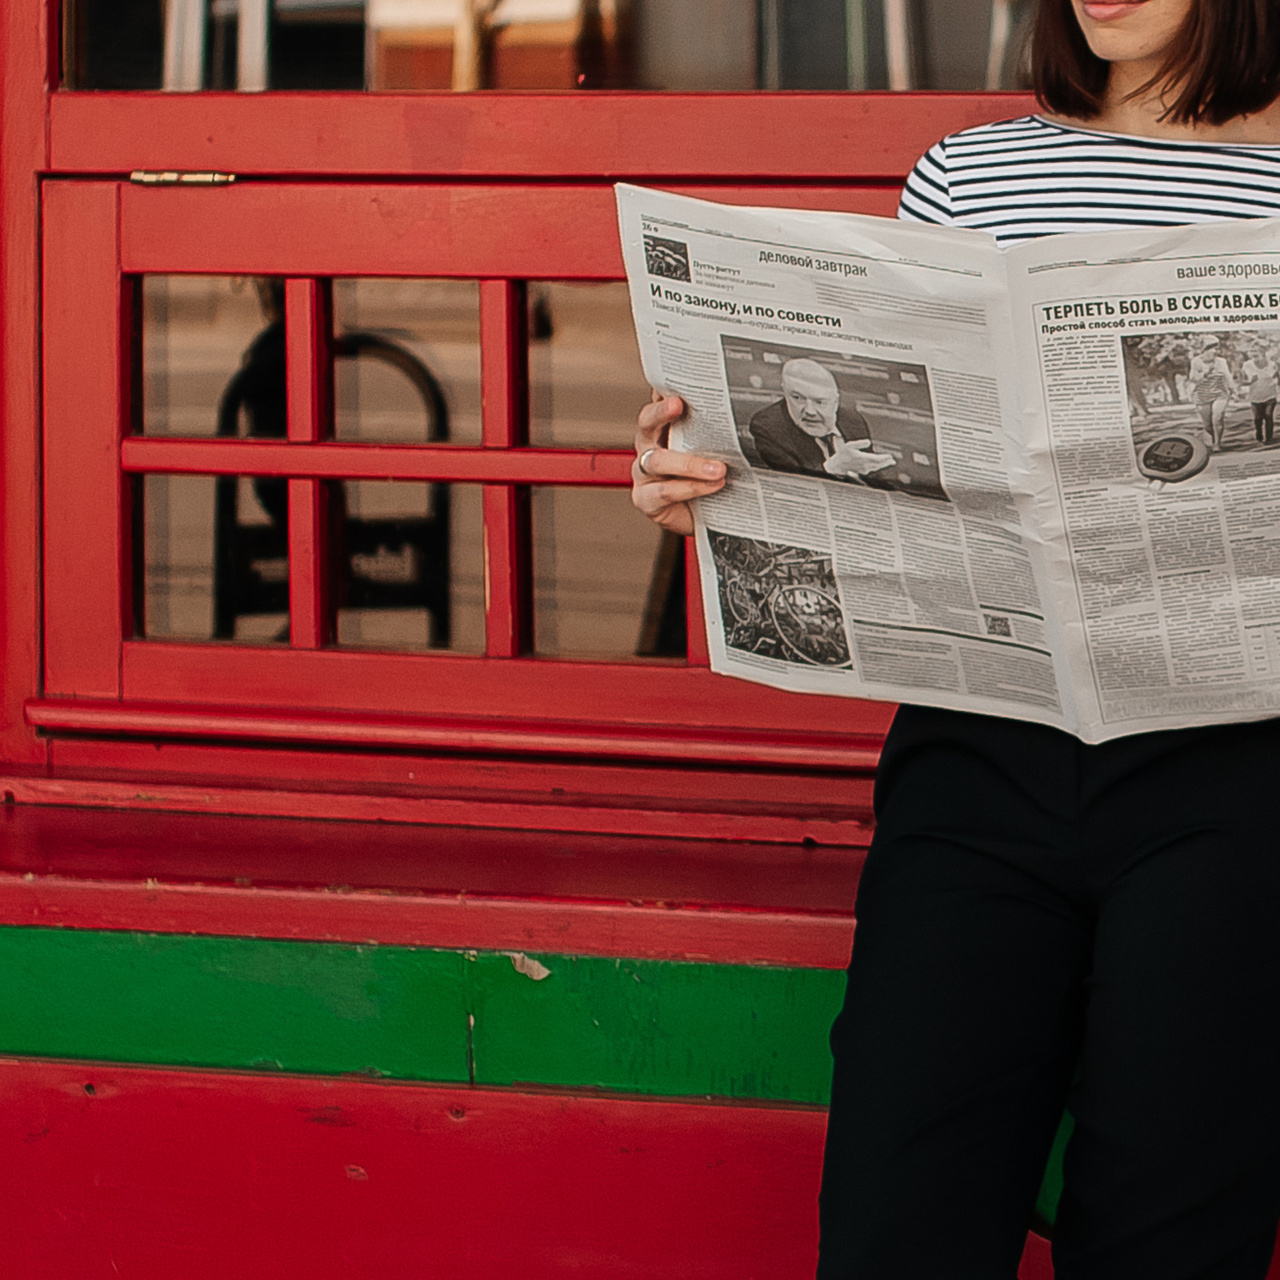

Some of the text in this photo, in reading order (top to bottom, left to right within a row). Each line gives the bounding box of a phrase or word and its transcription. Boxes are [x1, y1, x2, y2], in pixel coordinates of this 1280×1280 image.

[759, 250, 868, 277] деловой завтрак
[1177, 264, 1216, 279] ваше
[650, 283, 842, 328] И по закону, и по совести
[1043, 301, 1115, 321] ТЕРПЕТЬ
[1119, 298, 1163, 315] БОЛЬ
[1168, 298, 1178, 311] В
[1182, 293, 1265, 311] СУСТАВАХ
[1042, 321, 1087, 335] Простой
[1089, 318, 1126, 330] способ
[1128, 318, 1157, 328] стать
[1158, 315, 1211, 326] молодым
[1222, 312, 1278, 324] здоровым
